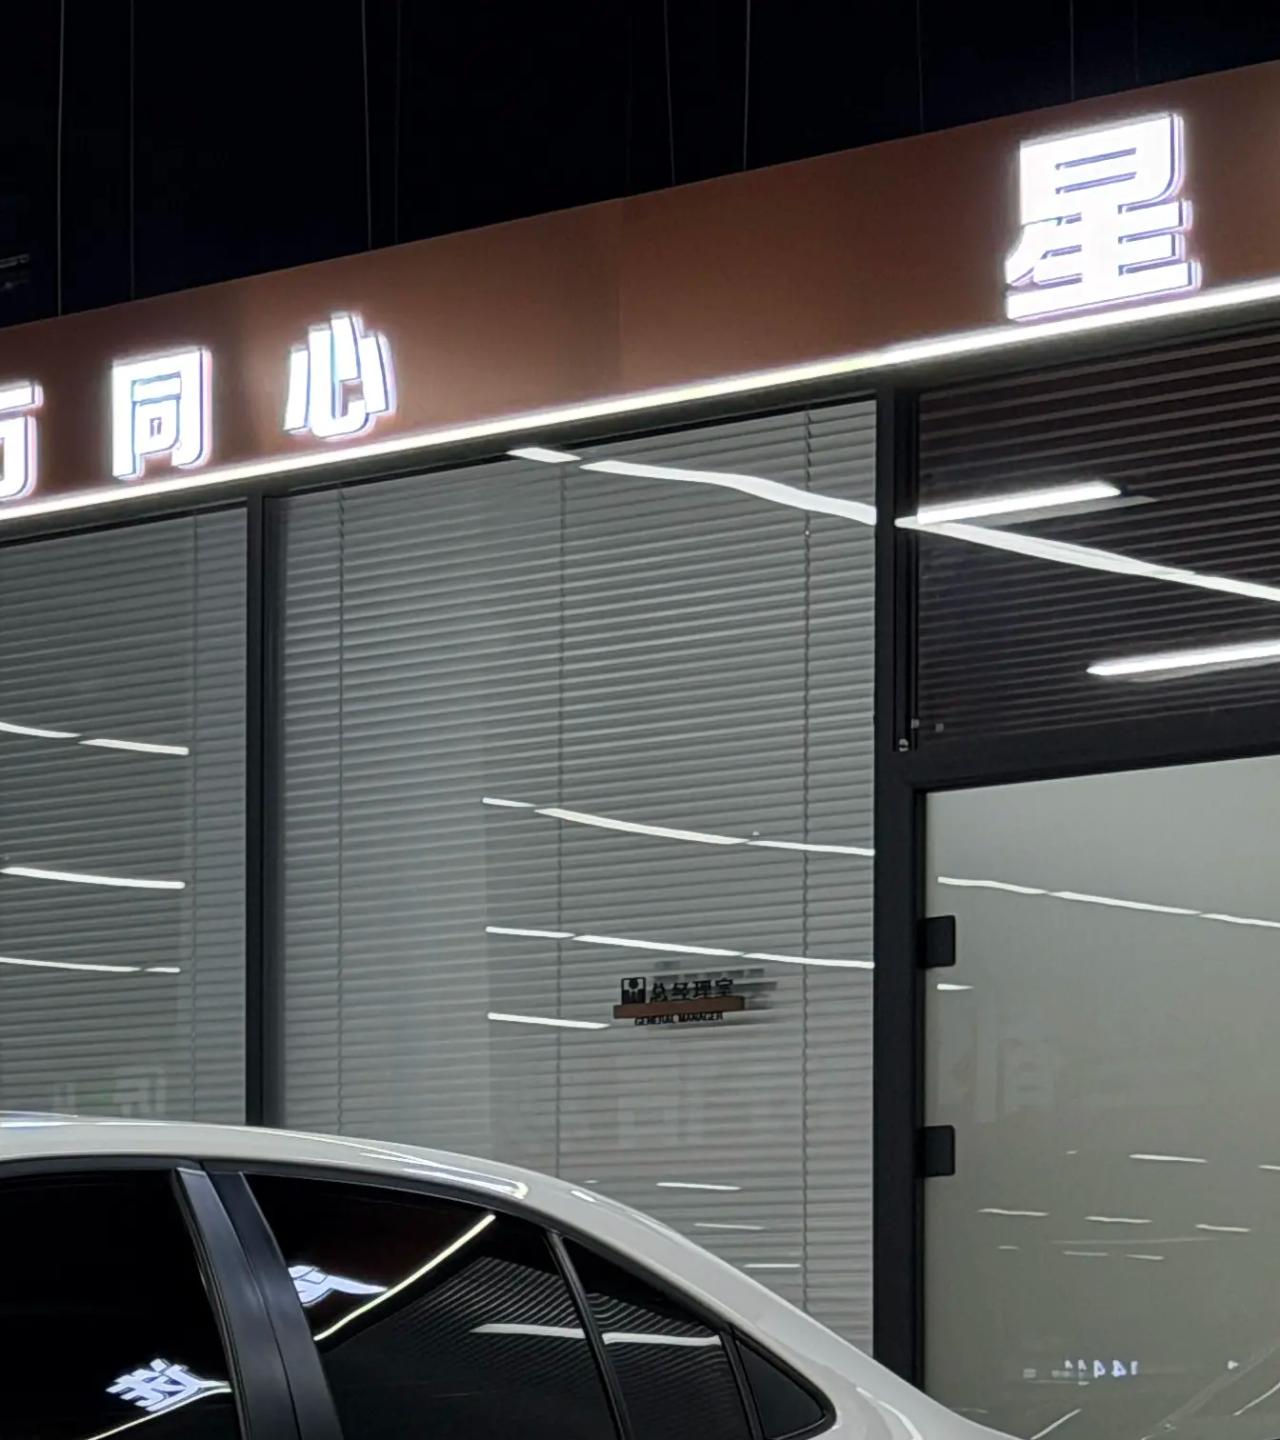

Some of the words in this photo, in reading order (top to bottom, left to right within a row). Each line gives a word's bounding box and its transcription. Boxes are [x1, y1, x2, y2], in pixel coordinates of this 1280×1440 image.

[1005, 113, 1201, 322] 星
[651, 978, 734, 1001] 总经理室
